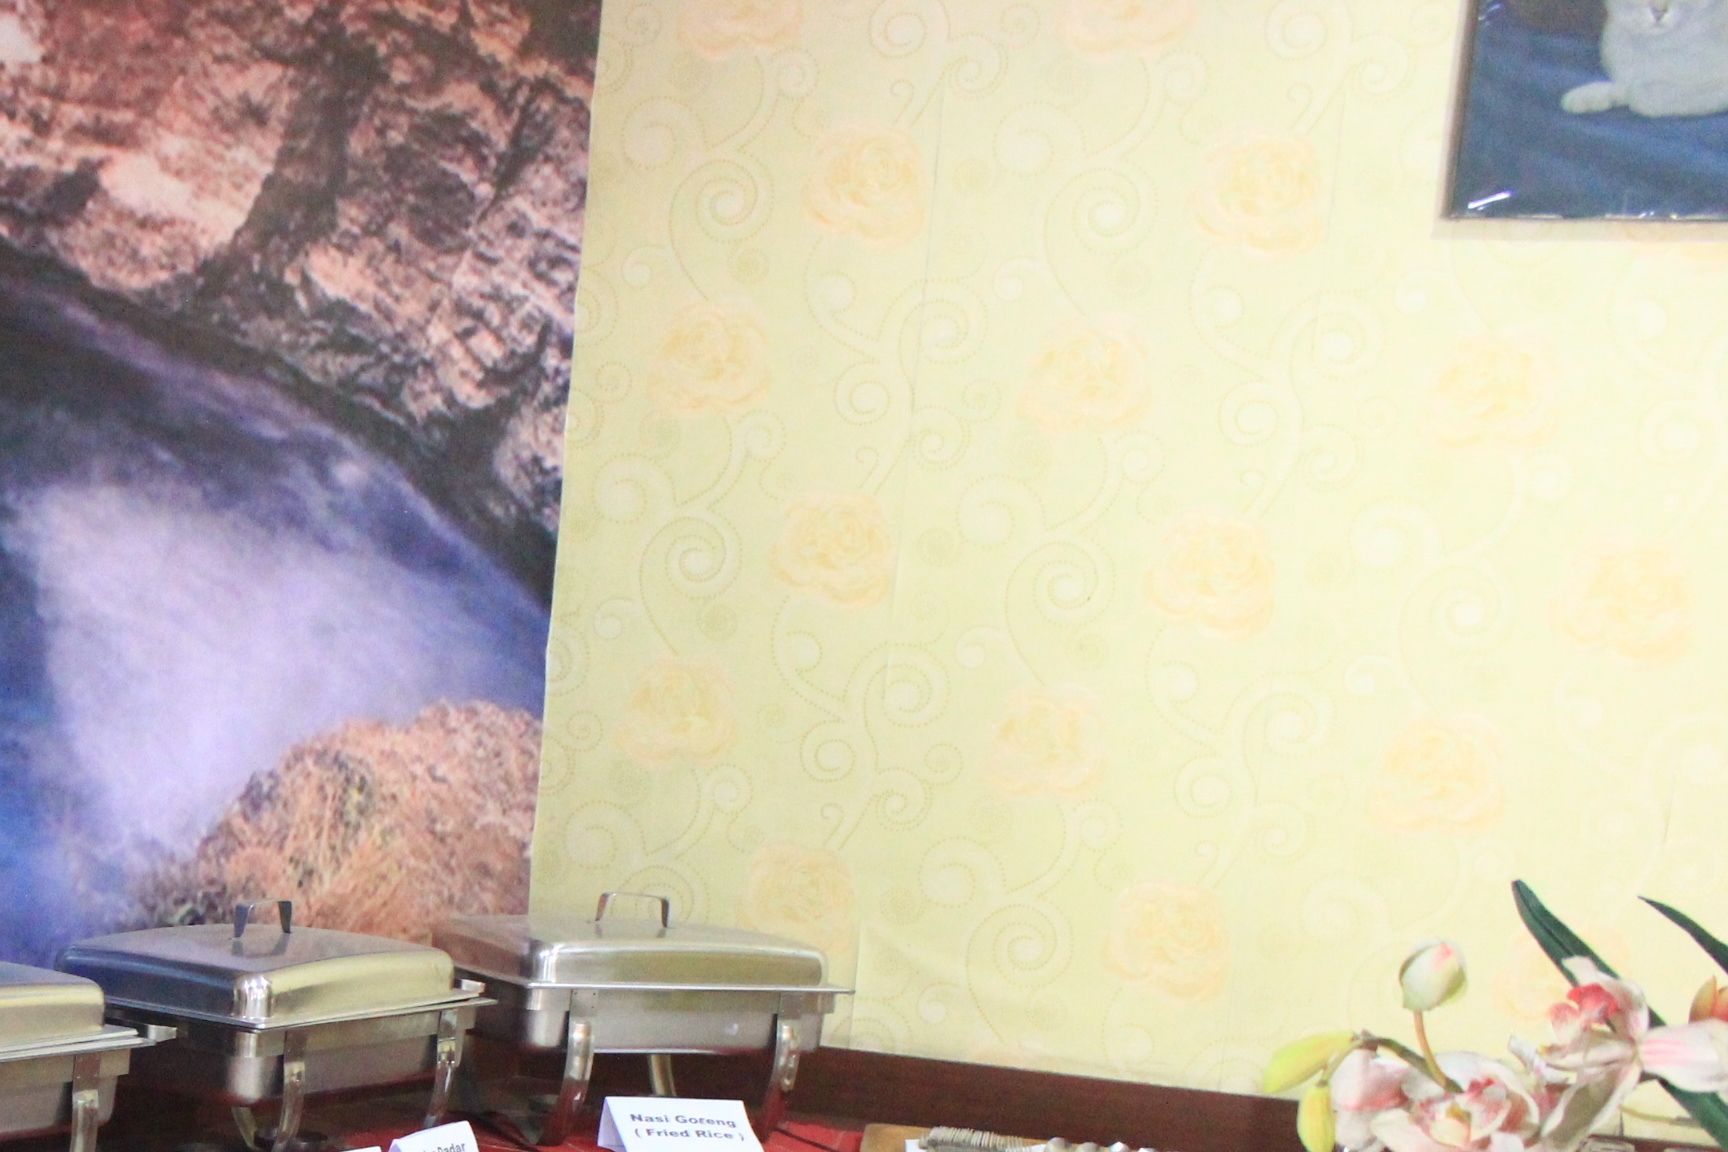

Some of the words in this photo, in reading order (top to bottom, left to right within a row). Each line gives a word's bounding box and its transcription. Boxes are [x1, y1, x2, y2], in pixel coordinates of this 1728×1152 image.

[630, 1113, 670, 1123] Nasi
[675, 1115, 737, 1128] Goreng
[646, 1128, 690, 1138] Fried
[694, 1128, 734, 1139] Rice
